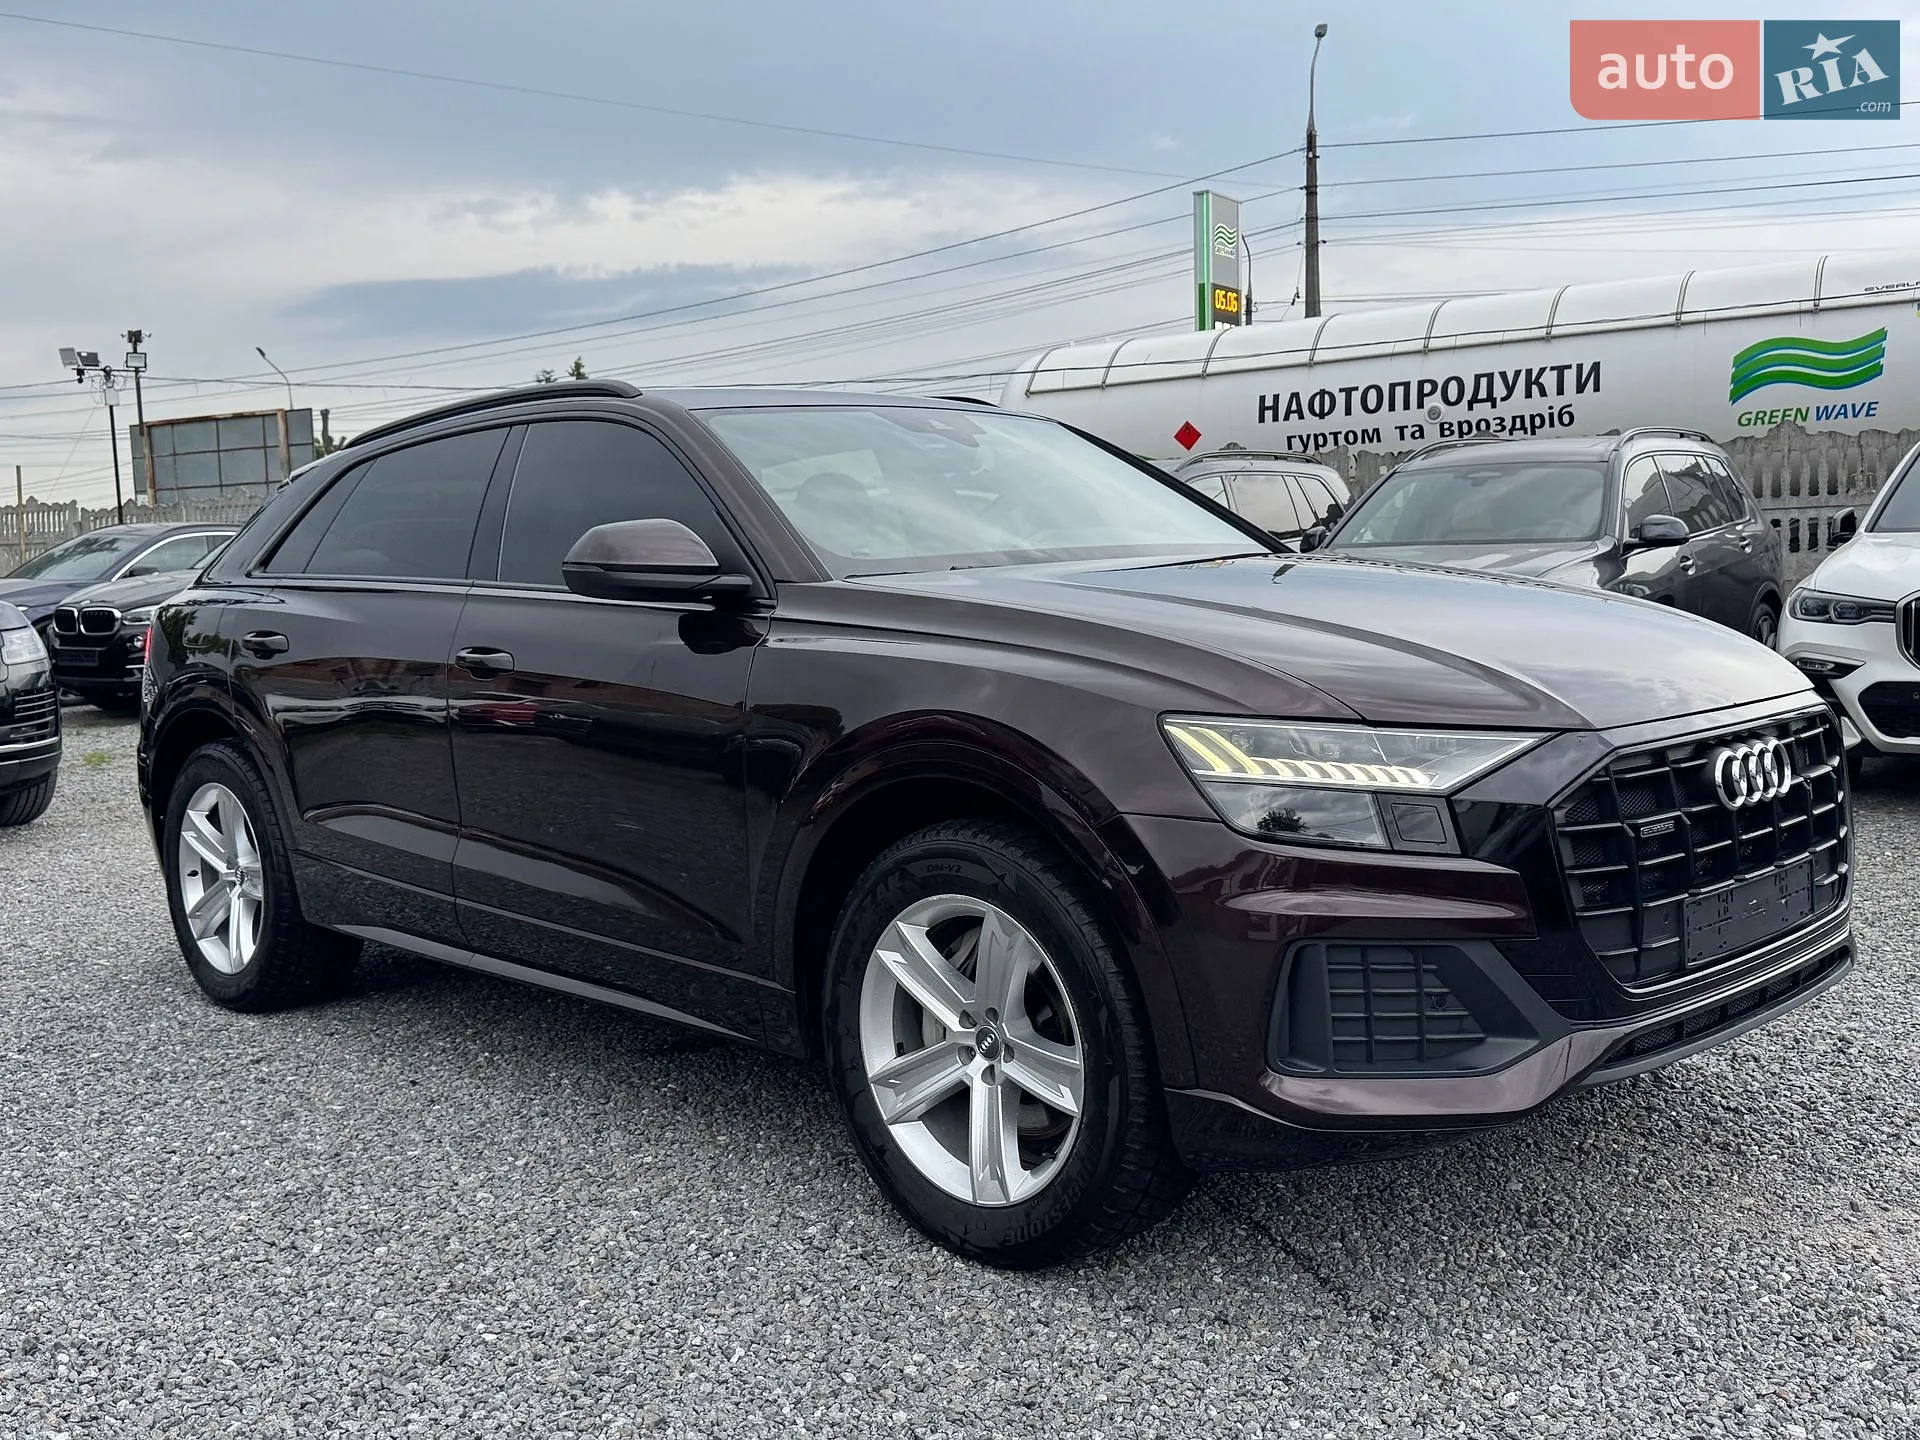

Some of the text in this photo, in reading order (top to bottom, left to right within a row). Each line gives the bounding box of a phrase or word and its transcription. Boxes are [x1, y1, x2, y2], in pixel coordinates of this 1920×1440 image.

[1257, 361, 1602, 424] НАФТОПРОДУКТИ
[1736, 401, 1879, 427] GREEN WAVE
[1286, 403, 1575, 453] гуртом та вроздріб
